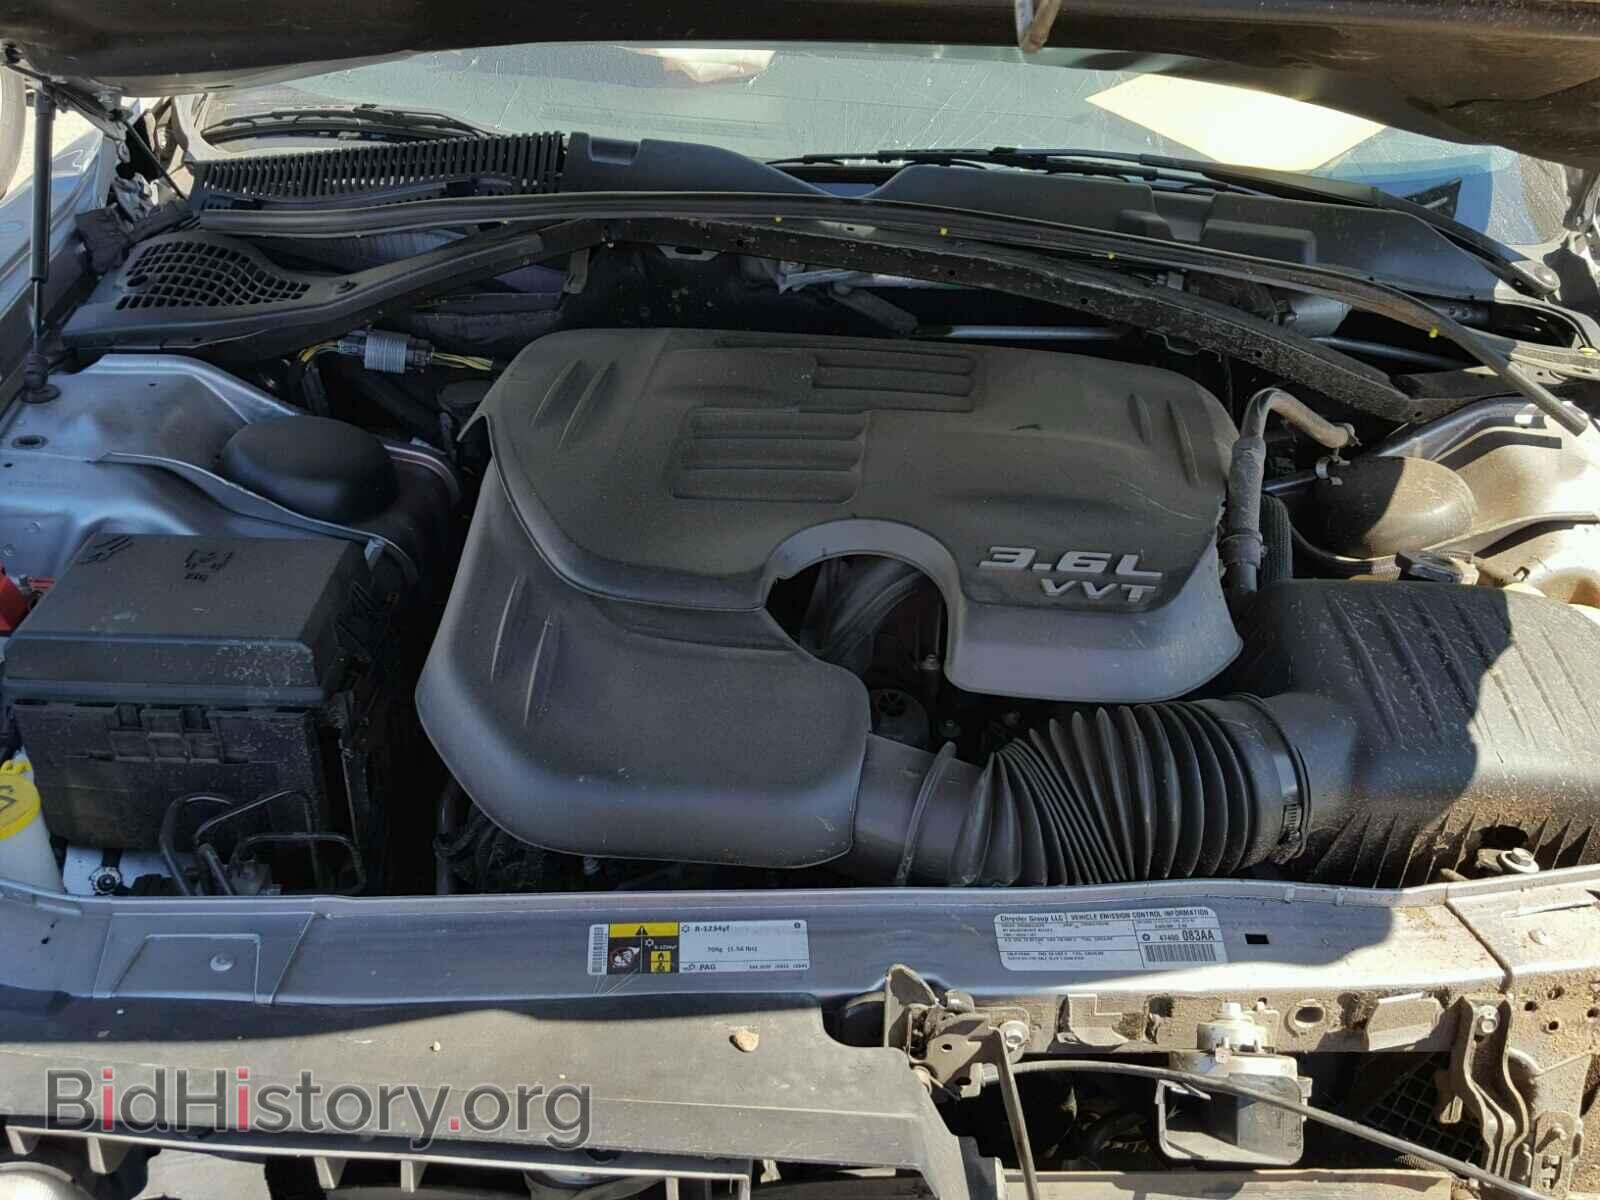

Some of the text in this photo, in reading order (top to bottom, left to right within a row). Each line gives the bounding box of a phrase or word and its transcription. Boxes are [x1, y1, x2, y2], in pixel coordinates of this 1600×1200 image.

[978, 545, 1164, 581] 3.6L
[1040, 578, 1157, 603] VVT
[1028, 915, 1049, 923] Group
[1070, 908, 1209, 921] VEHICLE EMISSION CONTROL INFORMATION
[1182, 929, 1216, 941] 083AA
